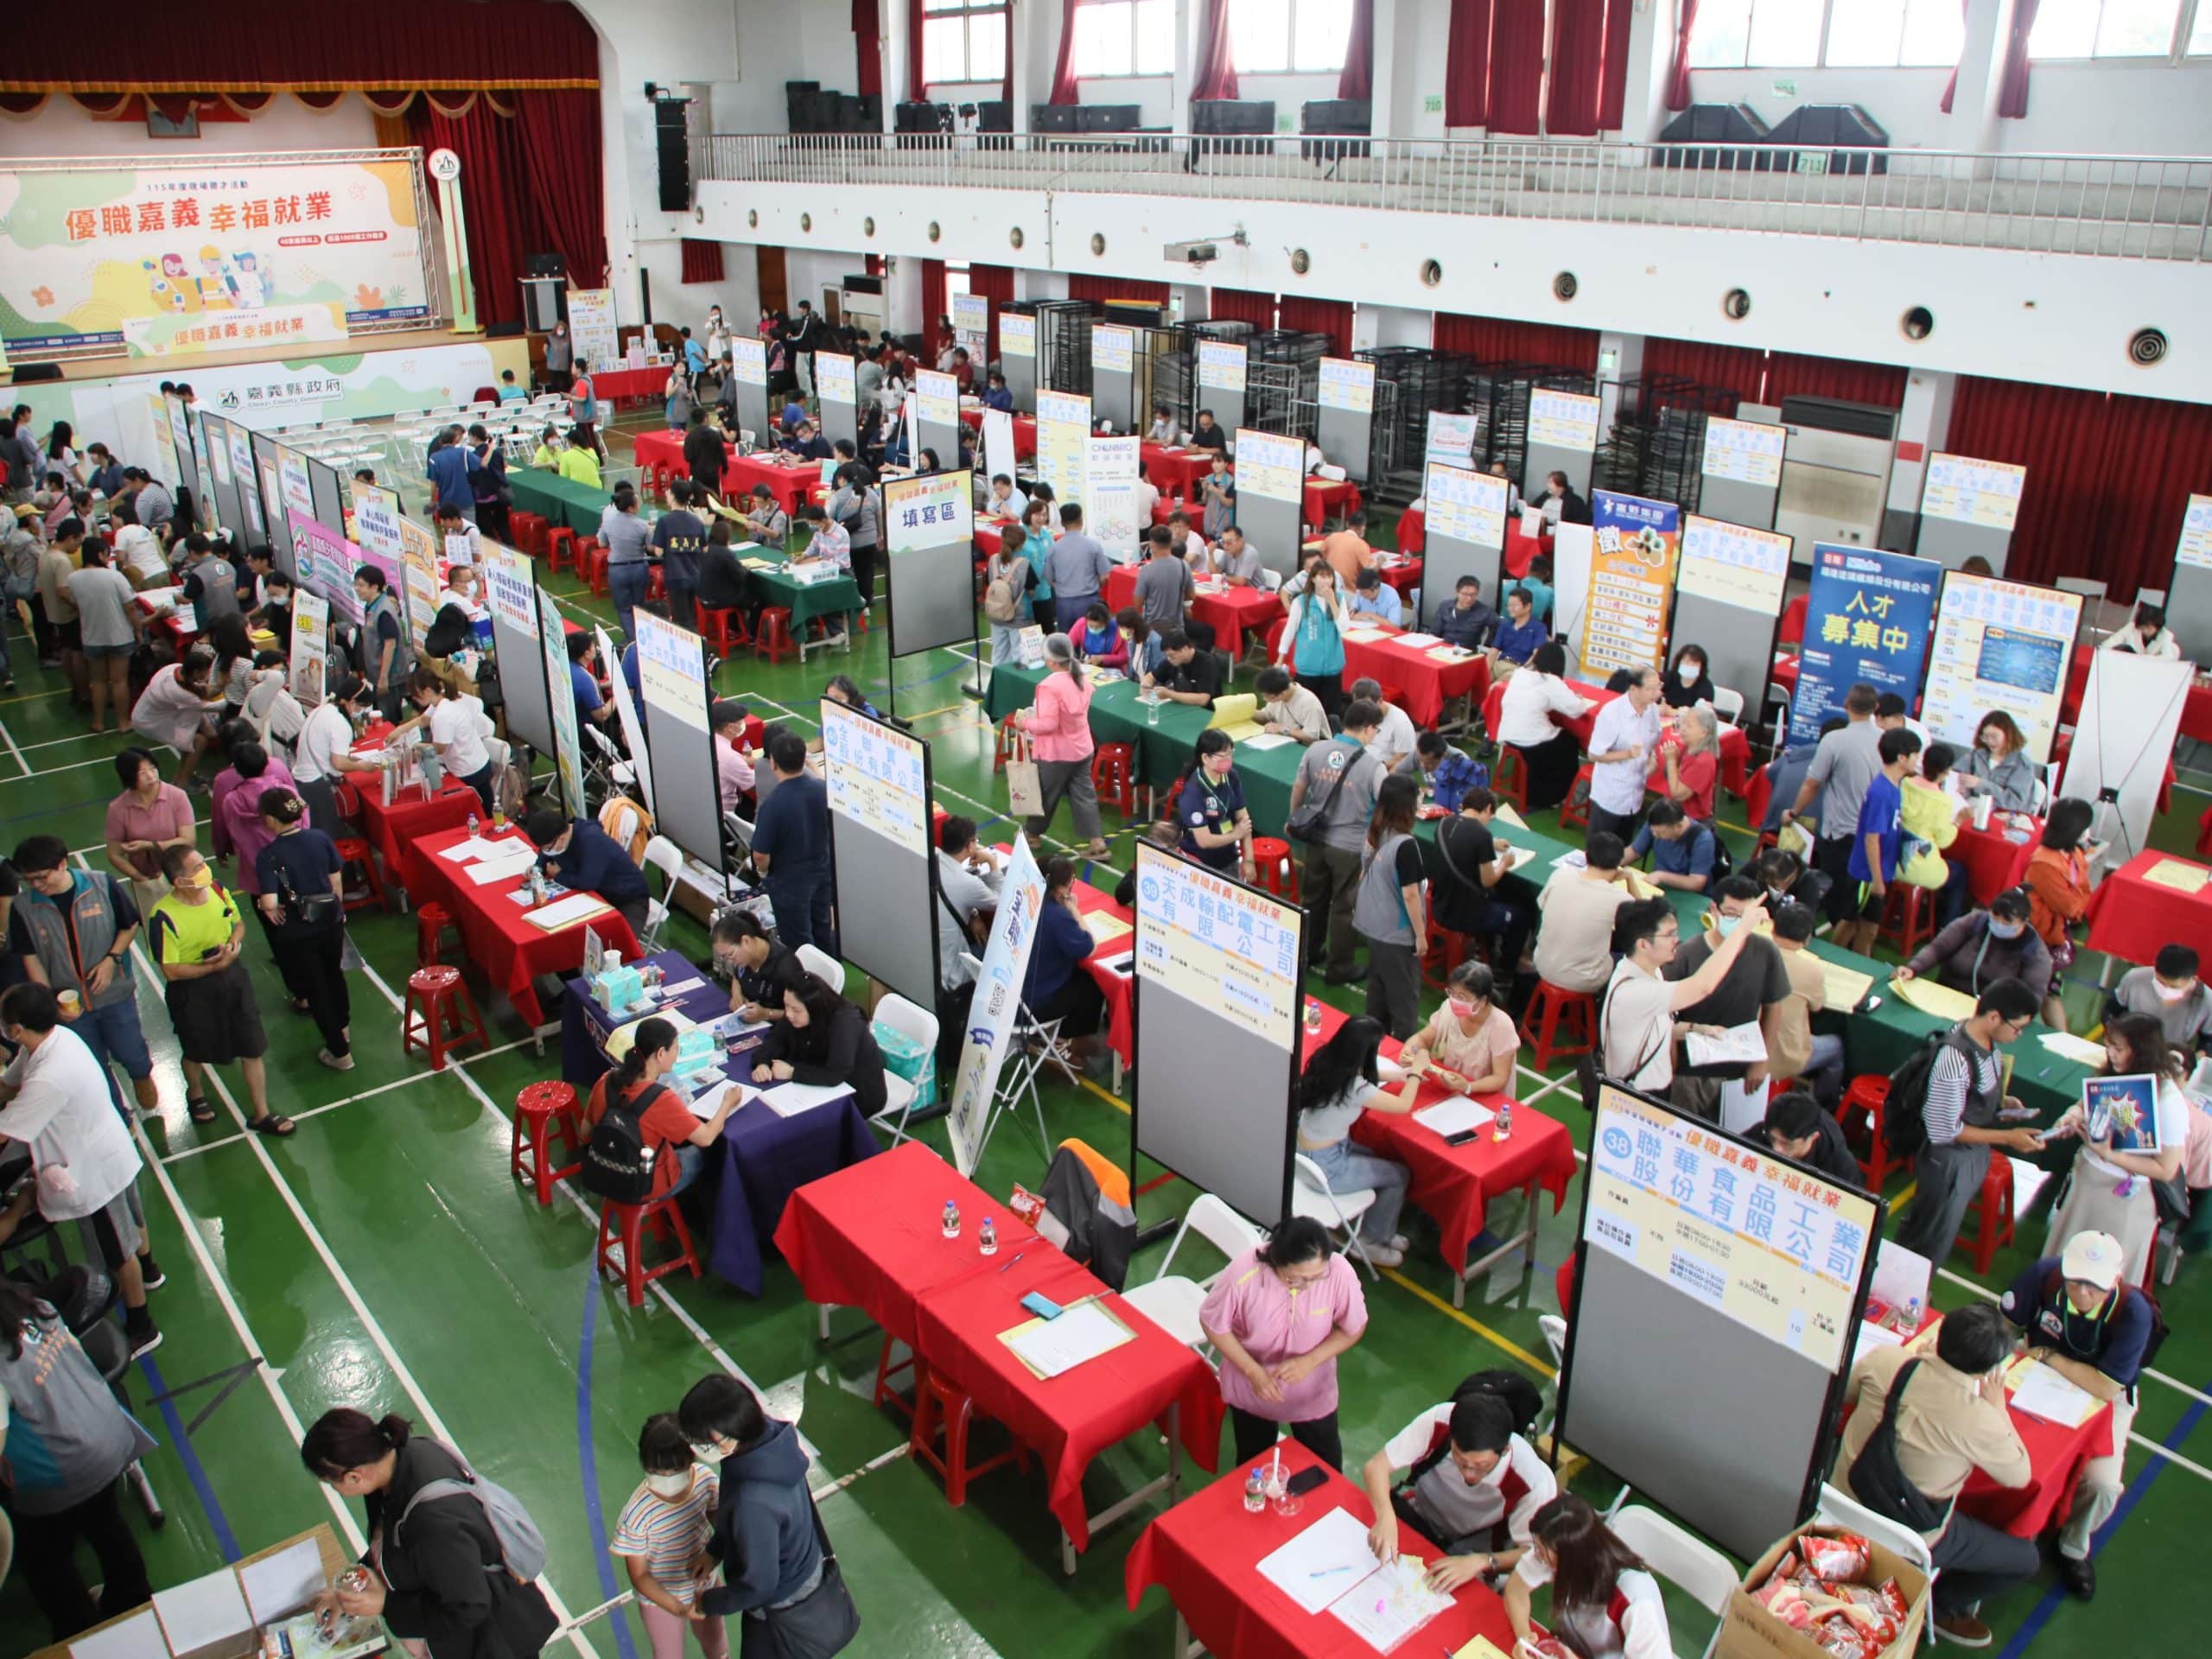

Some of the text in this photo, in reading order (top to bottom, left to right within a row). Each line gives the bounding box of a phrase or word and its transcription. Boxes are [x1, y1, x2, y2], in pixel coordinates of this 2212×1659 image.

[66, 191, 333, 241] 優職嘉義 幸福就業
[175, 317, 304, 346] 優職嘉義 幸福就業
[246, 378, 340, 399] 嘉義縣政府
[903, 501, 956, 528] 填寫區
[1845, 589, 1895, 620] 人才
[1821, 613, 1909, 655] 募集中
[1142, 880, 1159, 897] 39
[1236, 891, 1282, 921] 幸福就業
[1162, 875, 1295, 955] 天成輸配電工程
[1162, 898, 1294, 977] 有限公司
[1605, 1128, 1630, 1155] 38
[1686, 1128, 1758, 1174] 優職嘉義
[1764, 1160, 1842, 1210] 幸福就業
[1636, 1128, 1864, 1255] 聯華食品工業
[1632, 1155, 1855, 1281] 股份有限公司
